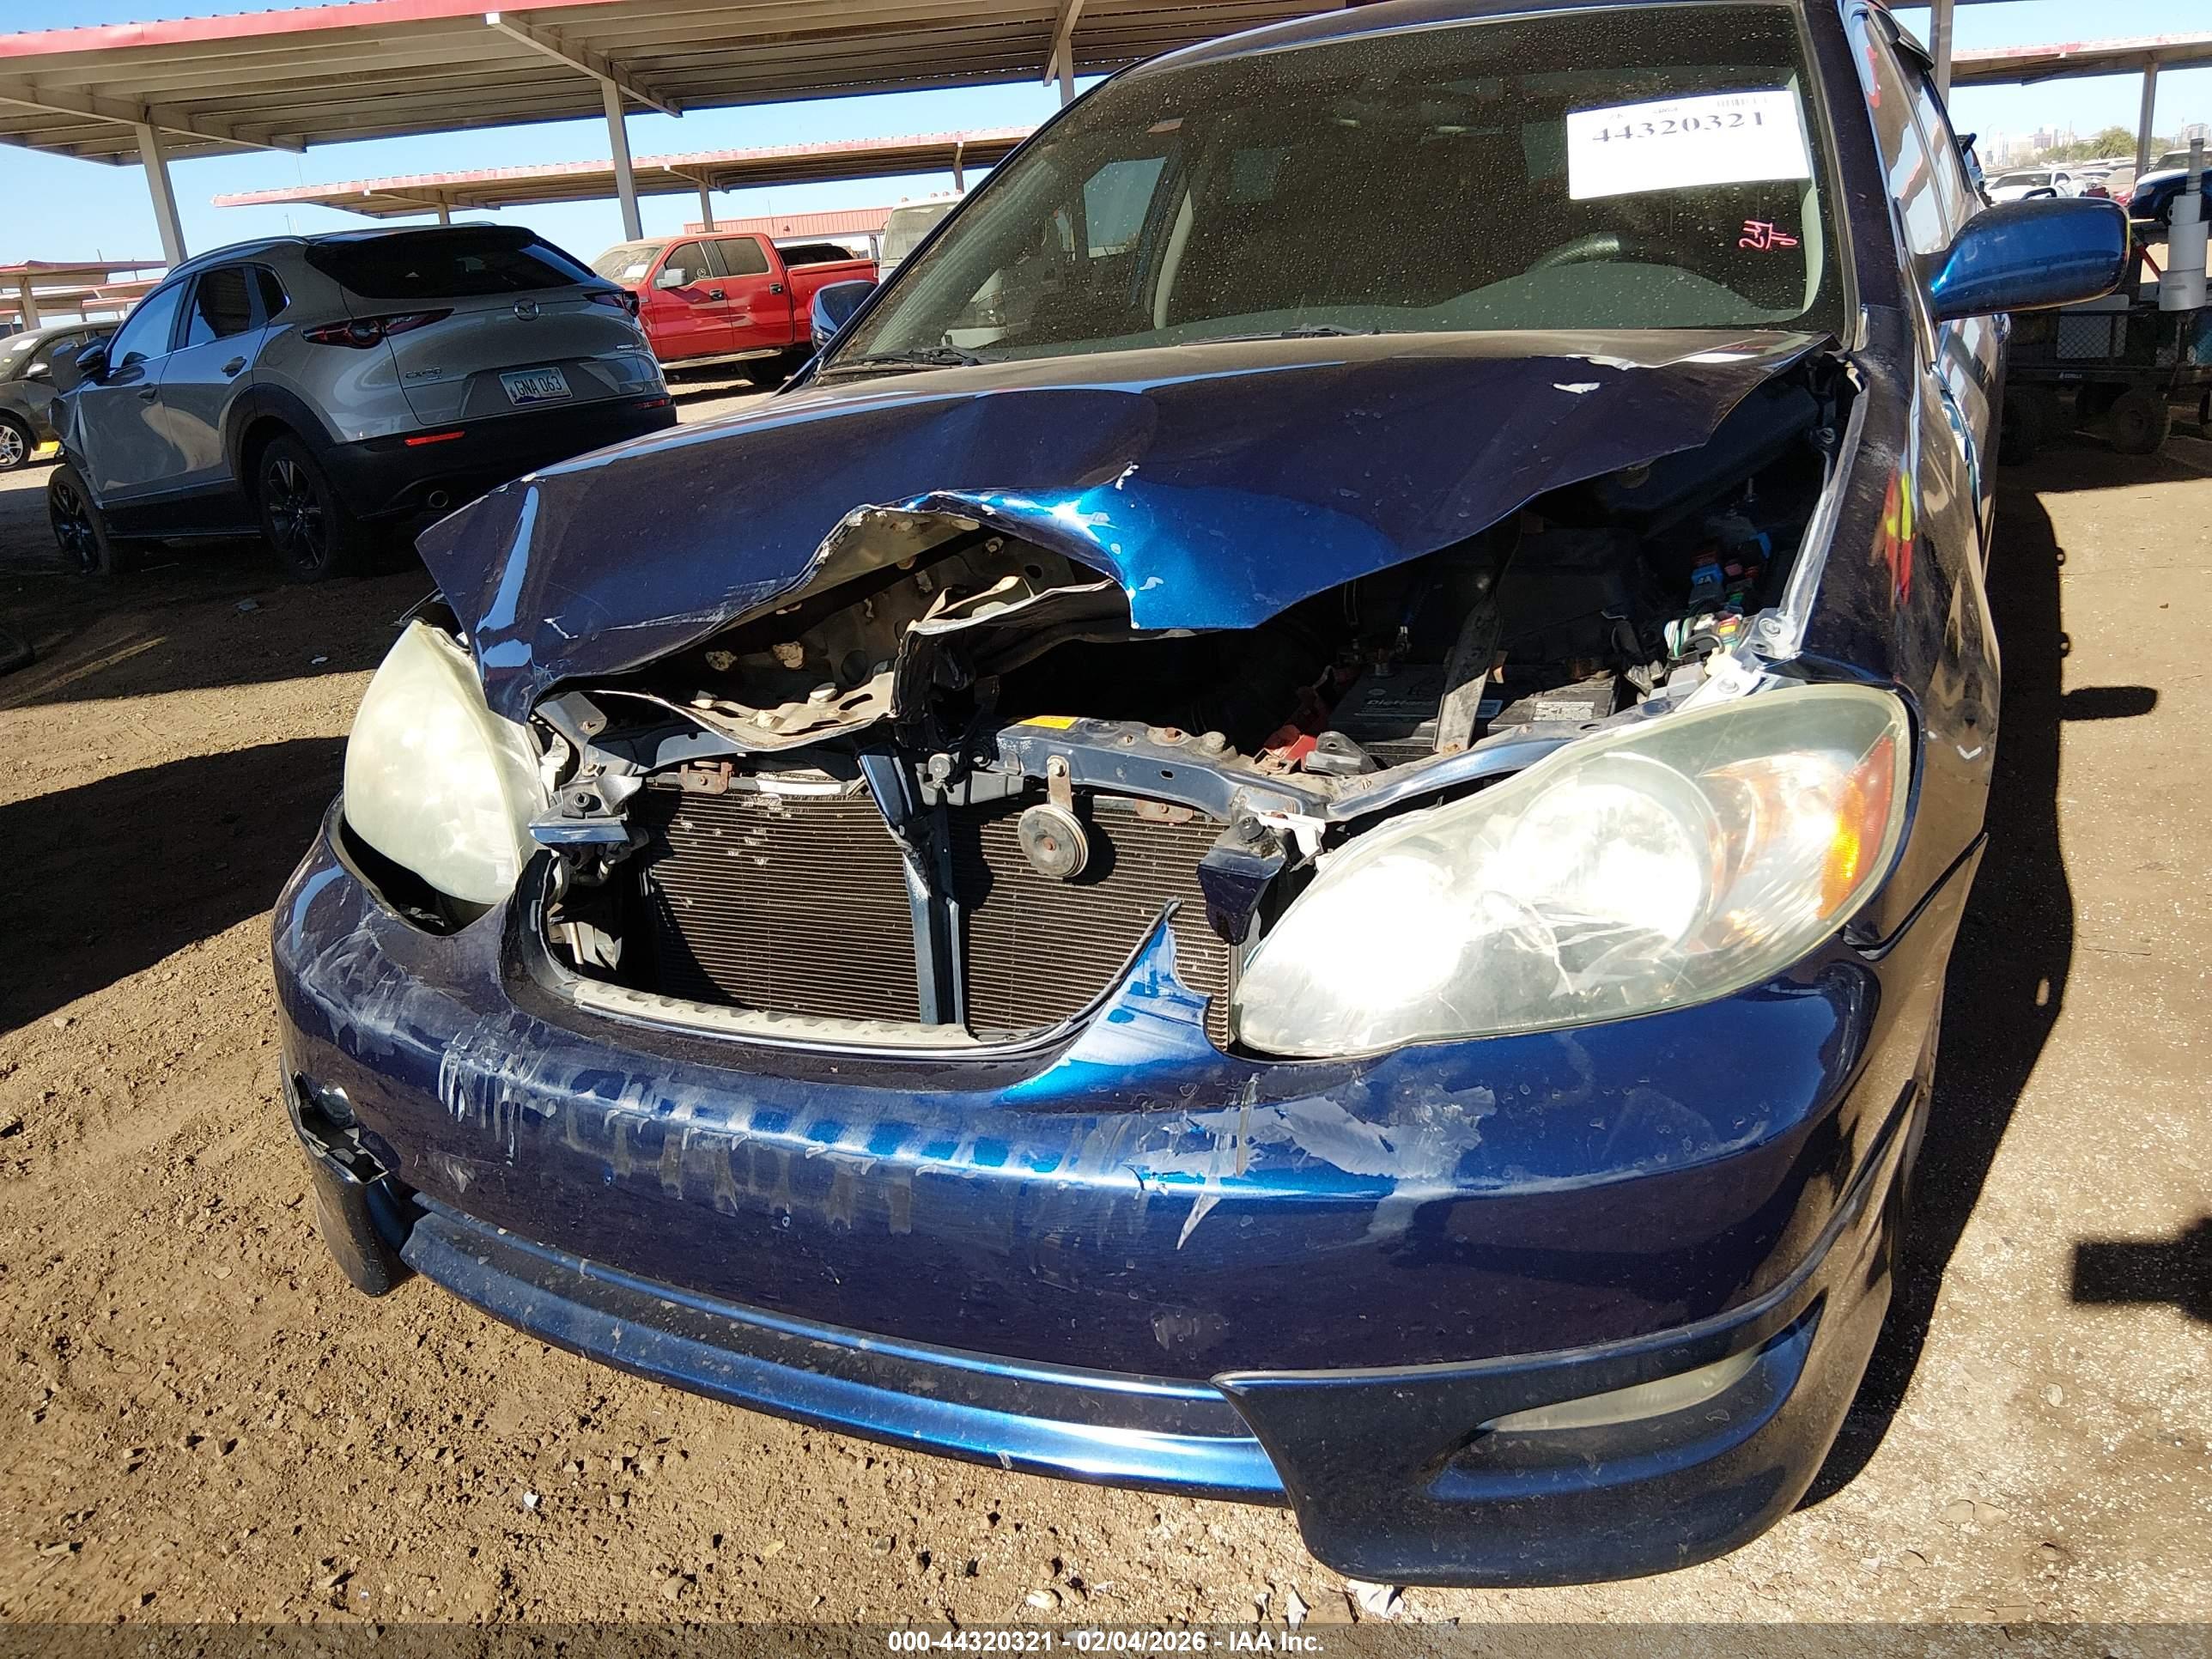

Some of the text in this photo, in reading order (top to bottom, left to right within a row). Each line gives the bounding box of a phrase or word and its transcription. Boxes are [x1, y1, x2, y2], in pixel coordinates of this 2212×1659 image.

[1592, 111, 1764, 143] 44320321
[514, 375, 562, 396] GNA 063
